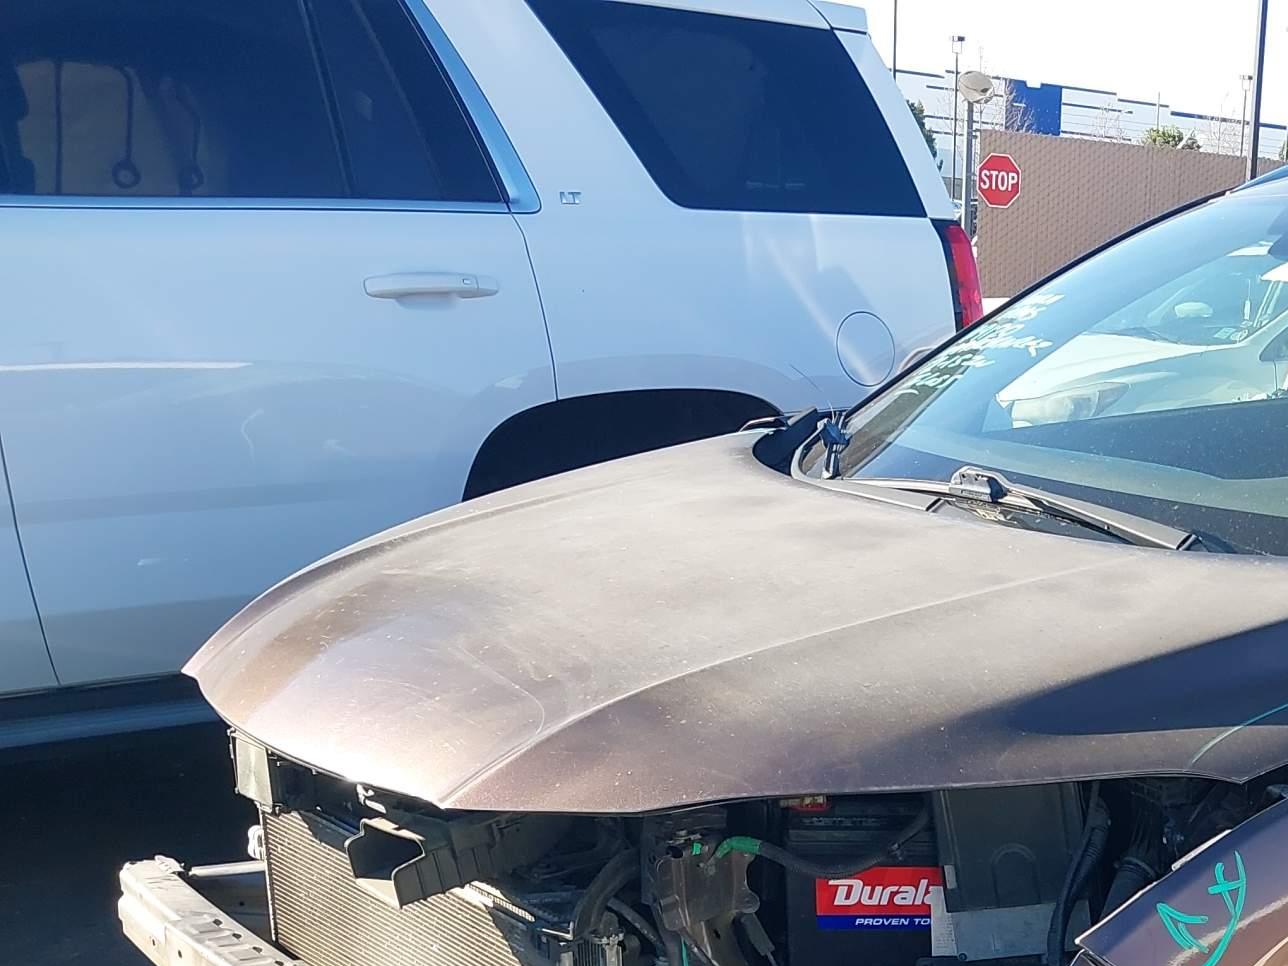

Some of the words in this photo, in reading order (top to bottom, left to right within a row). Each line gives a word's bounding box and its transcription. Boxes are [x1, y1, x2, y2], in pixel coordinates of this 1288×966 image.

[980, 169, 1018, 192] STOP
[559, 191, 582, 205] LT
[855, 918, 909, 926] PROVEN
